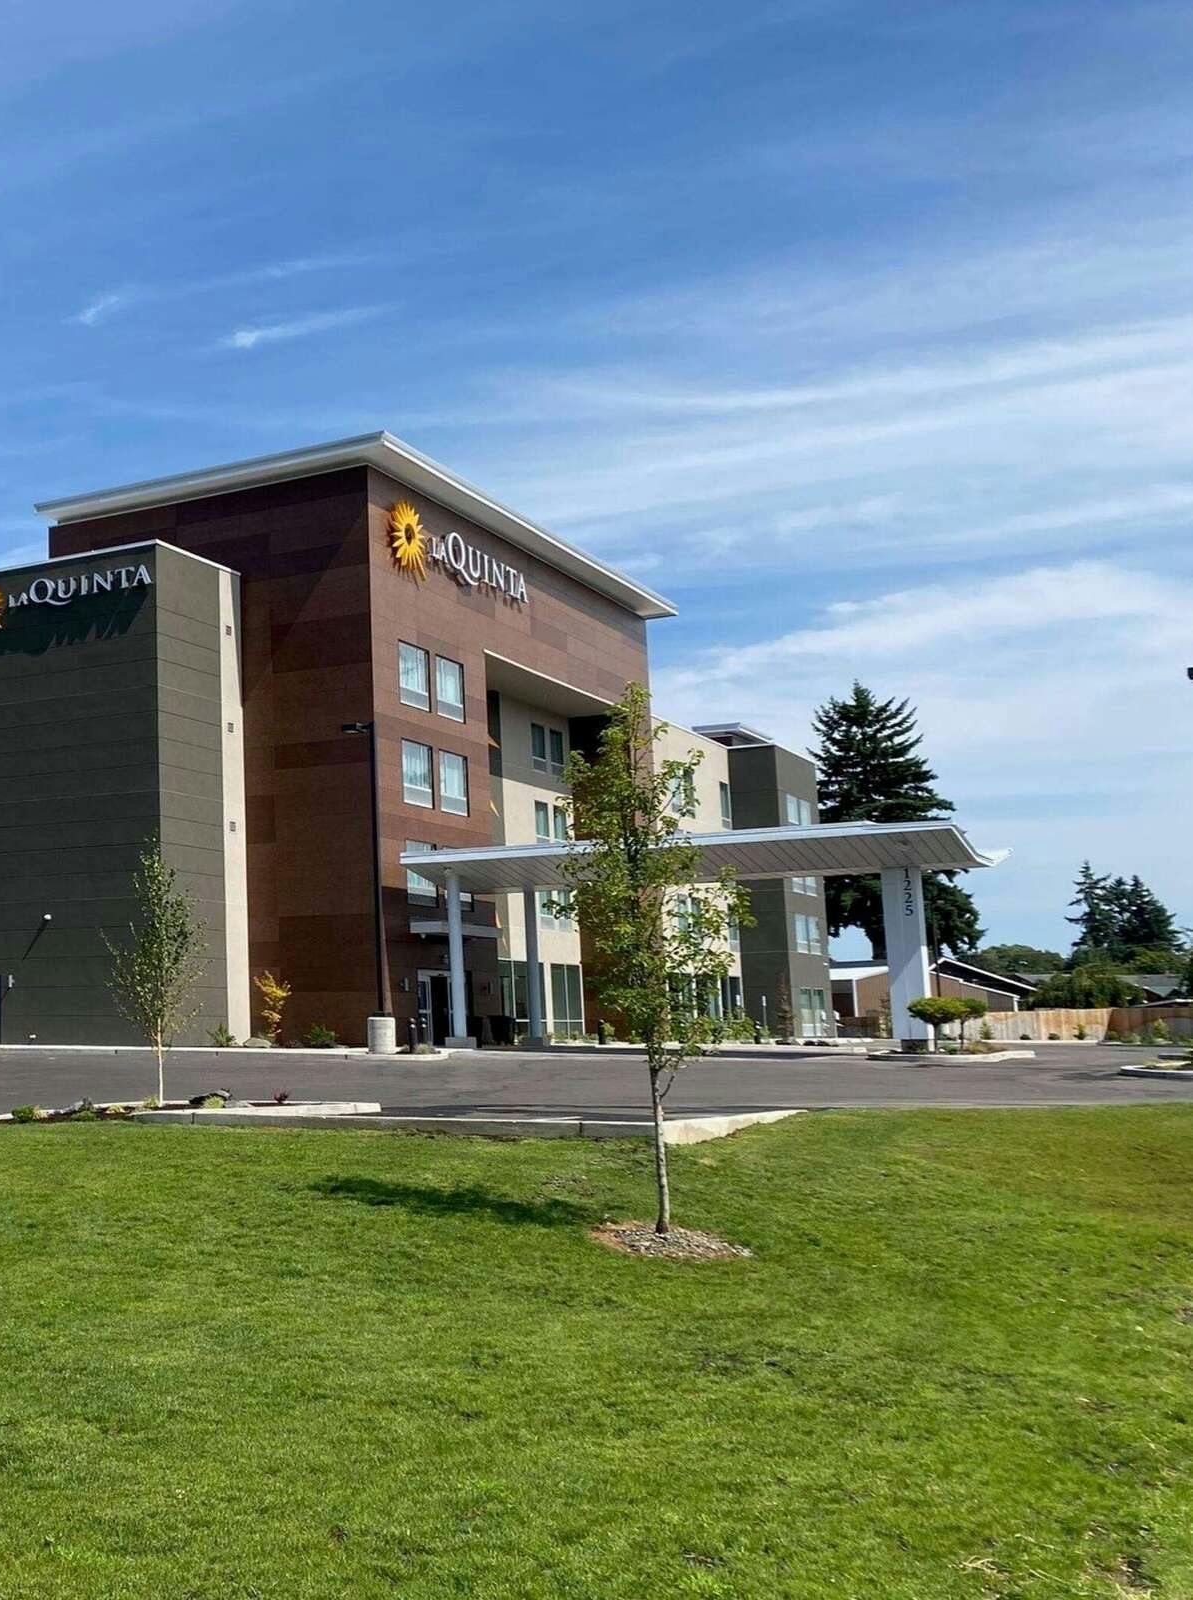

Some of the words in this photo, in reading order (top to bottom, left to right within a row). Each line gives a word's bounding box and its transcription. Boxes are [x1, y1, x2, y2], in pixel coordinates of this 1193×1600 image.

[29, 564, 152, 606] QUINTA
[430, 536, 449, 564] LA
[448, 531, 529, 604] QUINTA
[903, 868, 913, 916] 1225
